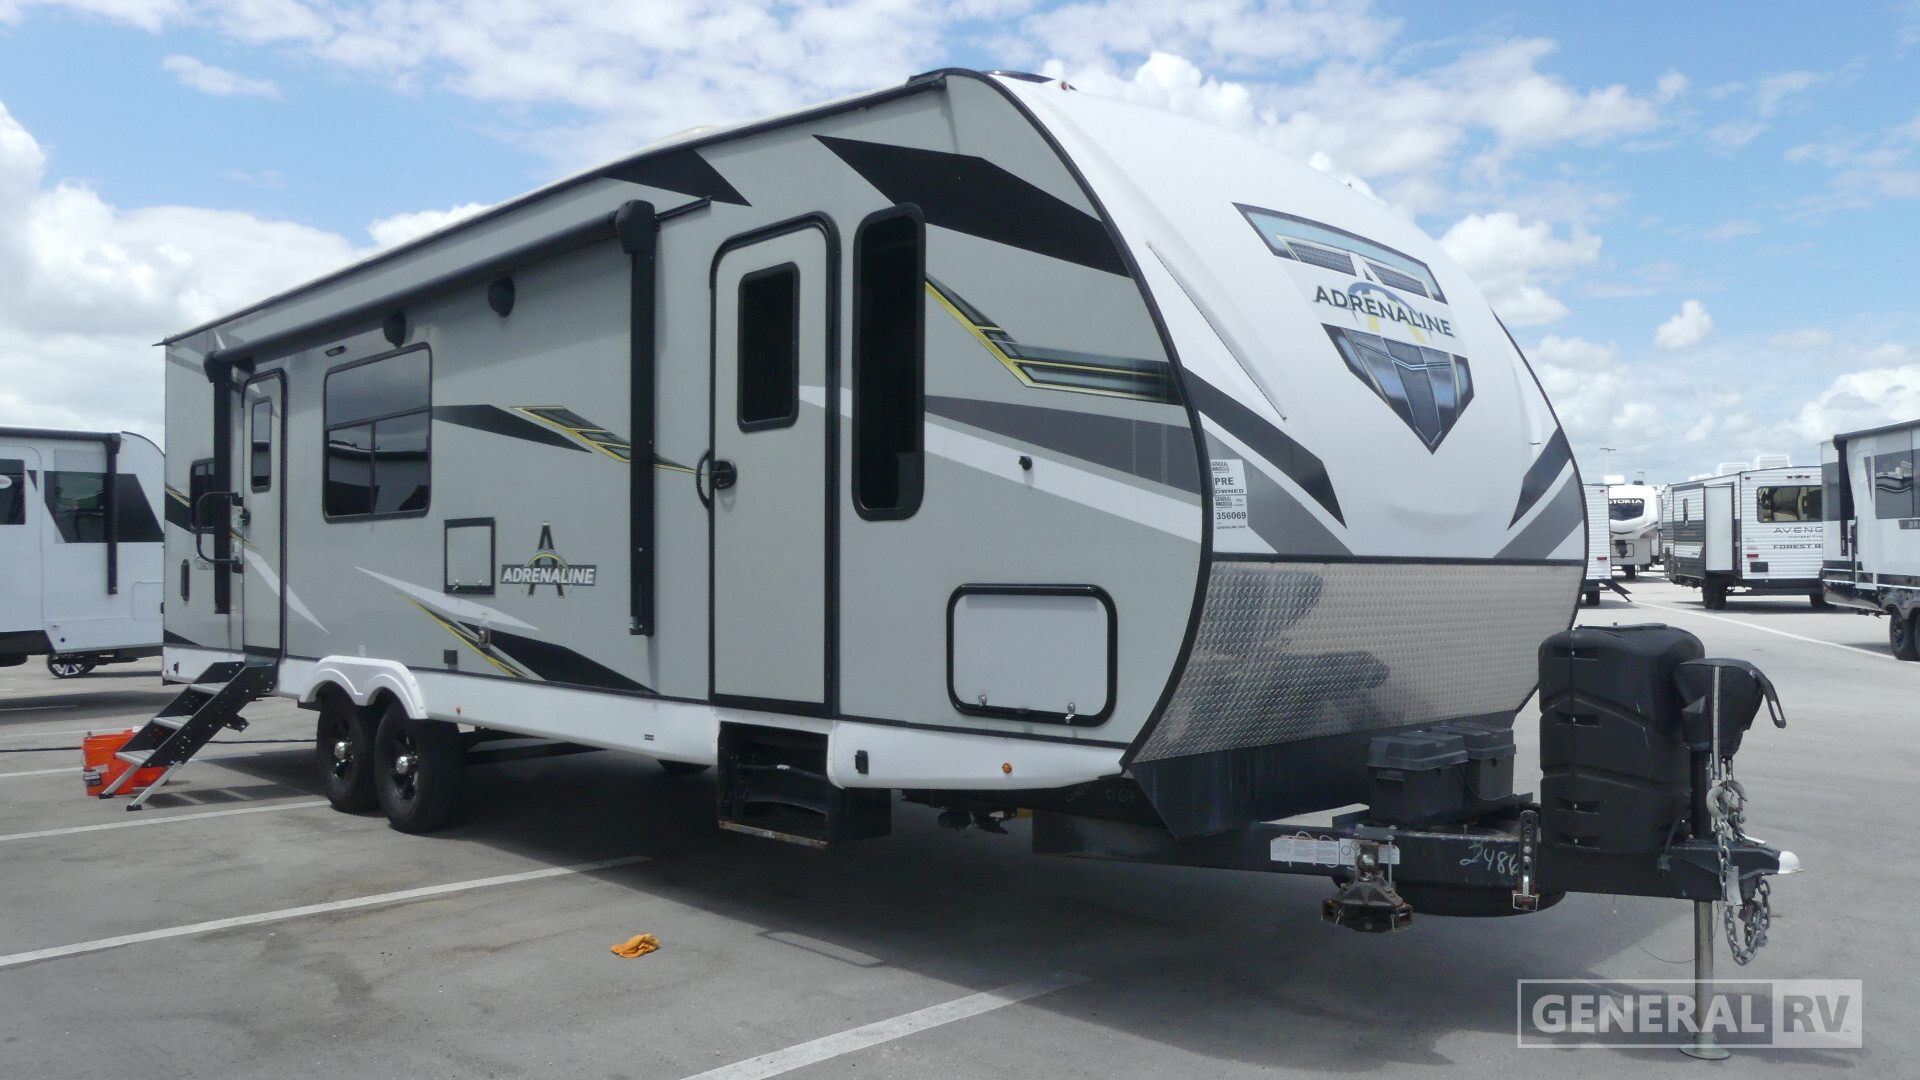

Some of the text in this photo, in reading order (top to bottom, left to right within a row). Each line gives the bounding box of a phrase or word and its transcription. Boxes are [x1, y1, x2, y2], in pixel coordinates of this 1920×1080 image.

[1313, 286, 1455, 338] ADRENALINE
[1215, 477, 1234, 486] PRE
[1216, 511, 1246, 520] 356069
[502, 566, 595, 584] ADRENALINE
